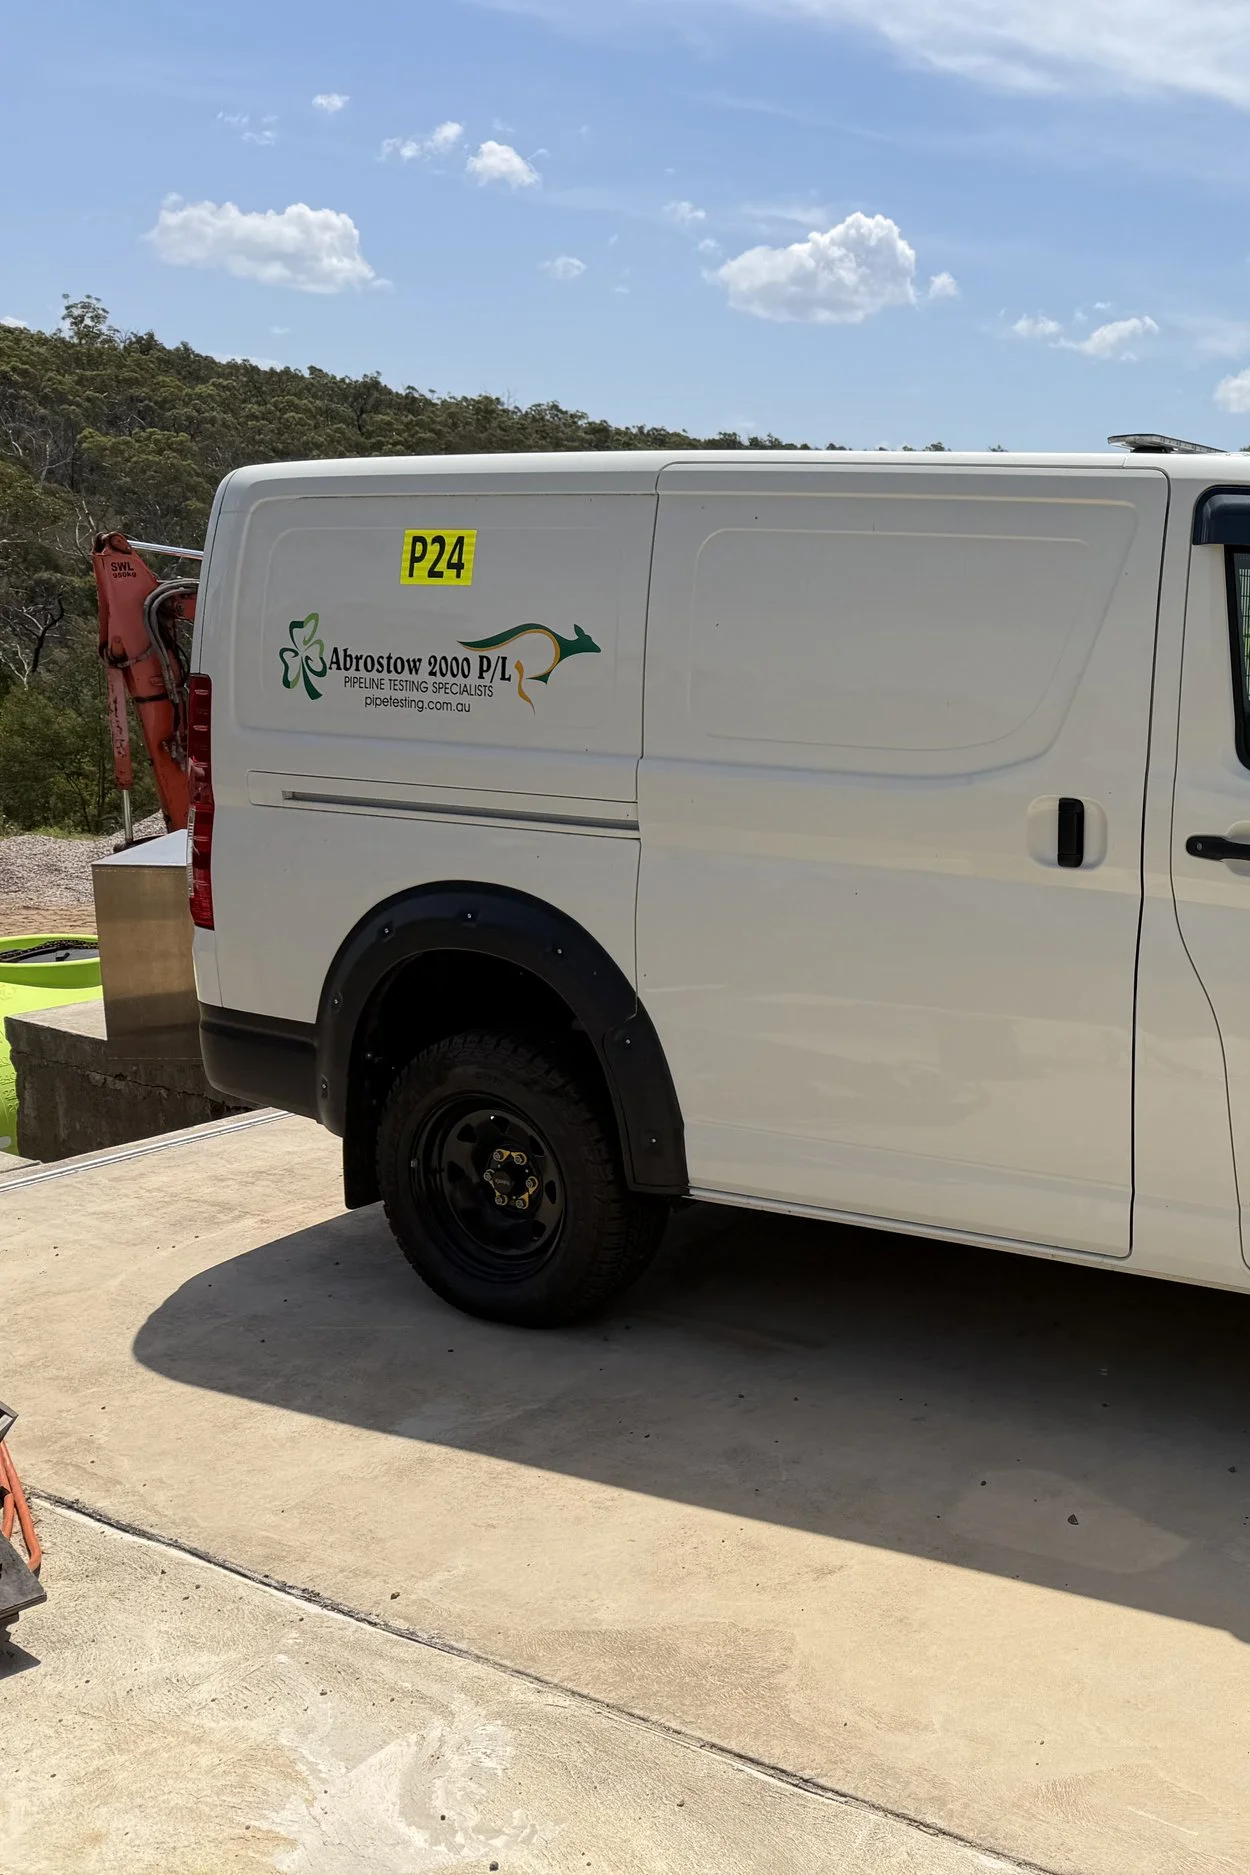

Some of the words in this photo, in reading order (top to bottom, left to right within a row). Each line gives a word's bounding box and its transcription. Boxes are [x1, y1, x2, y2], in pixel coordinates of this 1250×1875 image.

[110, 561, 134, 572] SWL
[408, 534, 466, 579] P24
[112, 571, 137, 579] 950kg
[328, 646, 422, 675] Abrostow
[428, 655, 471, 679] 2000
[477, 654, 512, 683] P/L
[344, 675, 386, 691] PIPELINE
[388, 678, 429, 694] TESTING
[431, 681, 494, 698] SPECIALISTS
[364, 694, 471, 713] pipetesting.com.au
